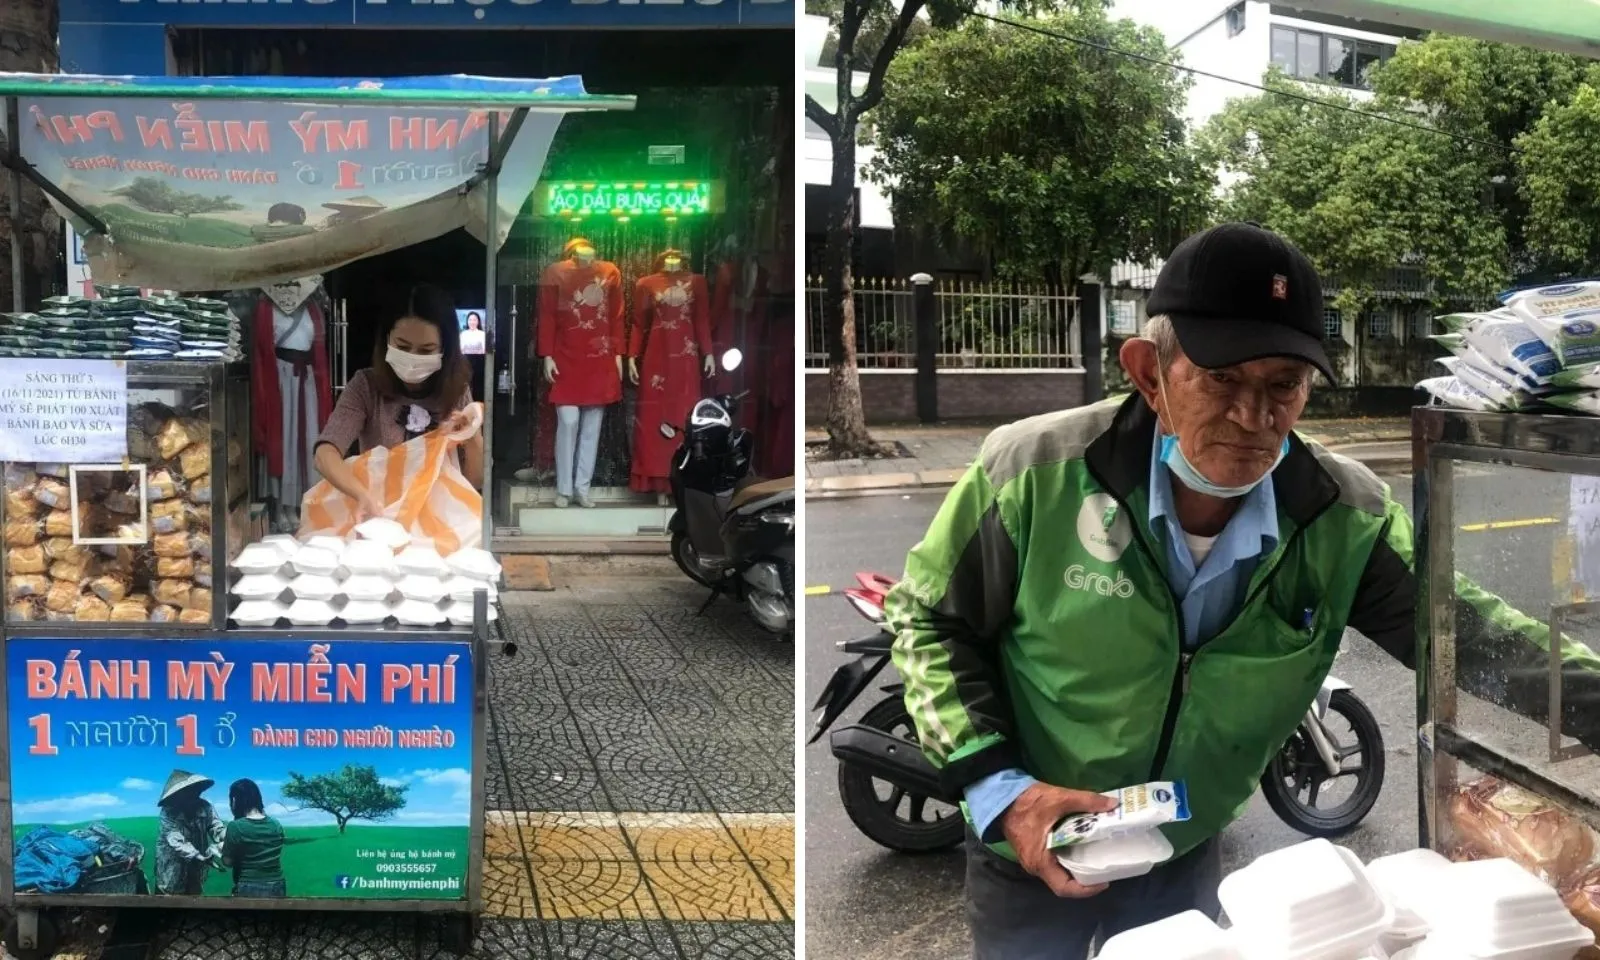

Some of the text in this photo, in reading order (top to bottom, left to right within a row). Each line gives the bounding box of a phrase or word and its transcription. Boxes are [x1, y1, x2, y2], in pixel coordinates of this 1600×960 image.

[555, 189, 578, 209] ÁO
[582, 188, 612, 209] DÀI
[25, 371, 94, 383] SÁNG THỨ 3
[2, 388, 63, 400] (16/11/2021)
[84, 387, 117, 400] BÁNH
[36, 402, 66, 414] PHÁT
[71, 405, 87, 415] 100
[7, 418, 112, 431] BÁNH BAO VÀ SỮA
[34, 433, 86, 446] LÚC 6H30
[1063, 564, 1135, 598] Grab
[26, 643, 460, 704] BÁNH MỲ MIỄN PHÍ
[28, 711, 455, 756] 1 NGƯỜI 1 Ổ DÀNH CHO NGƯỜI NGHÈO
[356, 849, 375, 858] Liên
[377, 849, 387, 859] hệ
[408, 849, 419, 859] hộ
[421, 849, 442, 858] bánh
[376, 863, 437, 873] 0903555657
[351, 876, 460, 891] /banhmymienphi
